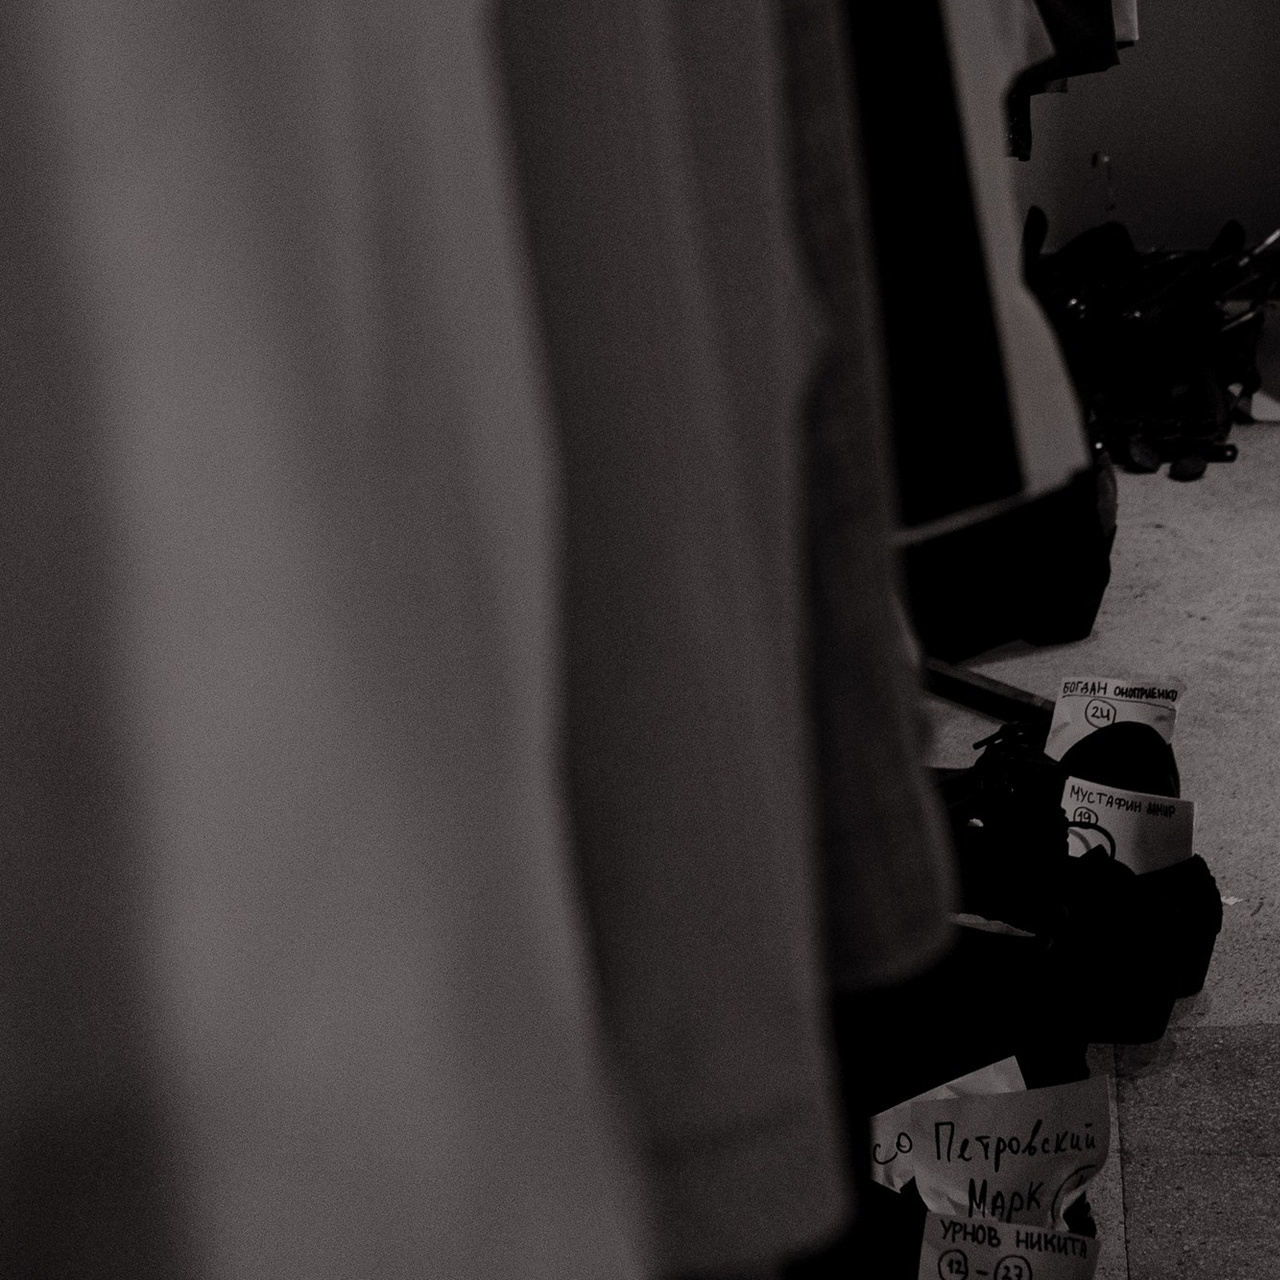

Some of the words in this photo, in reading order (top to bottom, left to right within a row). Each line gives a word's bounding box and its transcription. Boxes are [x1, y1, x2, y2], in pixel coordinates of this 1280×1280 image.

[1063, 681, 1107, 696] БОГДАН
[1091, 706, 1111, 721] 24
[1069, 785, 1142, 813] МУСТАФИН
[935, 1119, 1098, 1172] Петровский
[940, 1220, 1001, 1247] УРНОВ
[1016, 1230, 1088, 1259] НИКИТА
